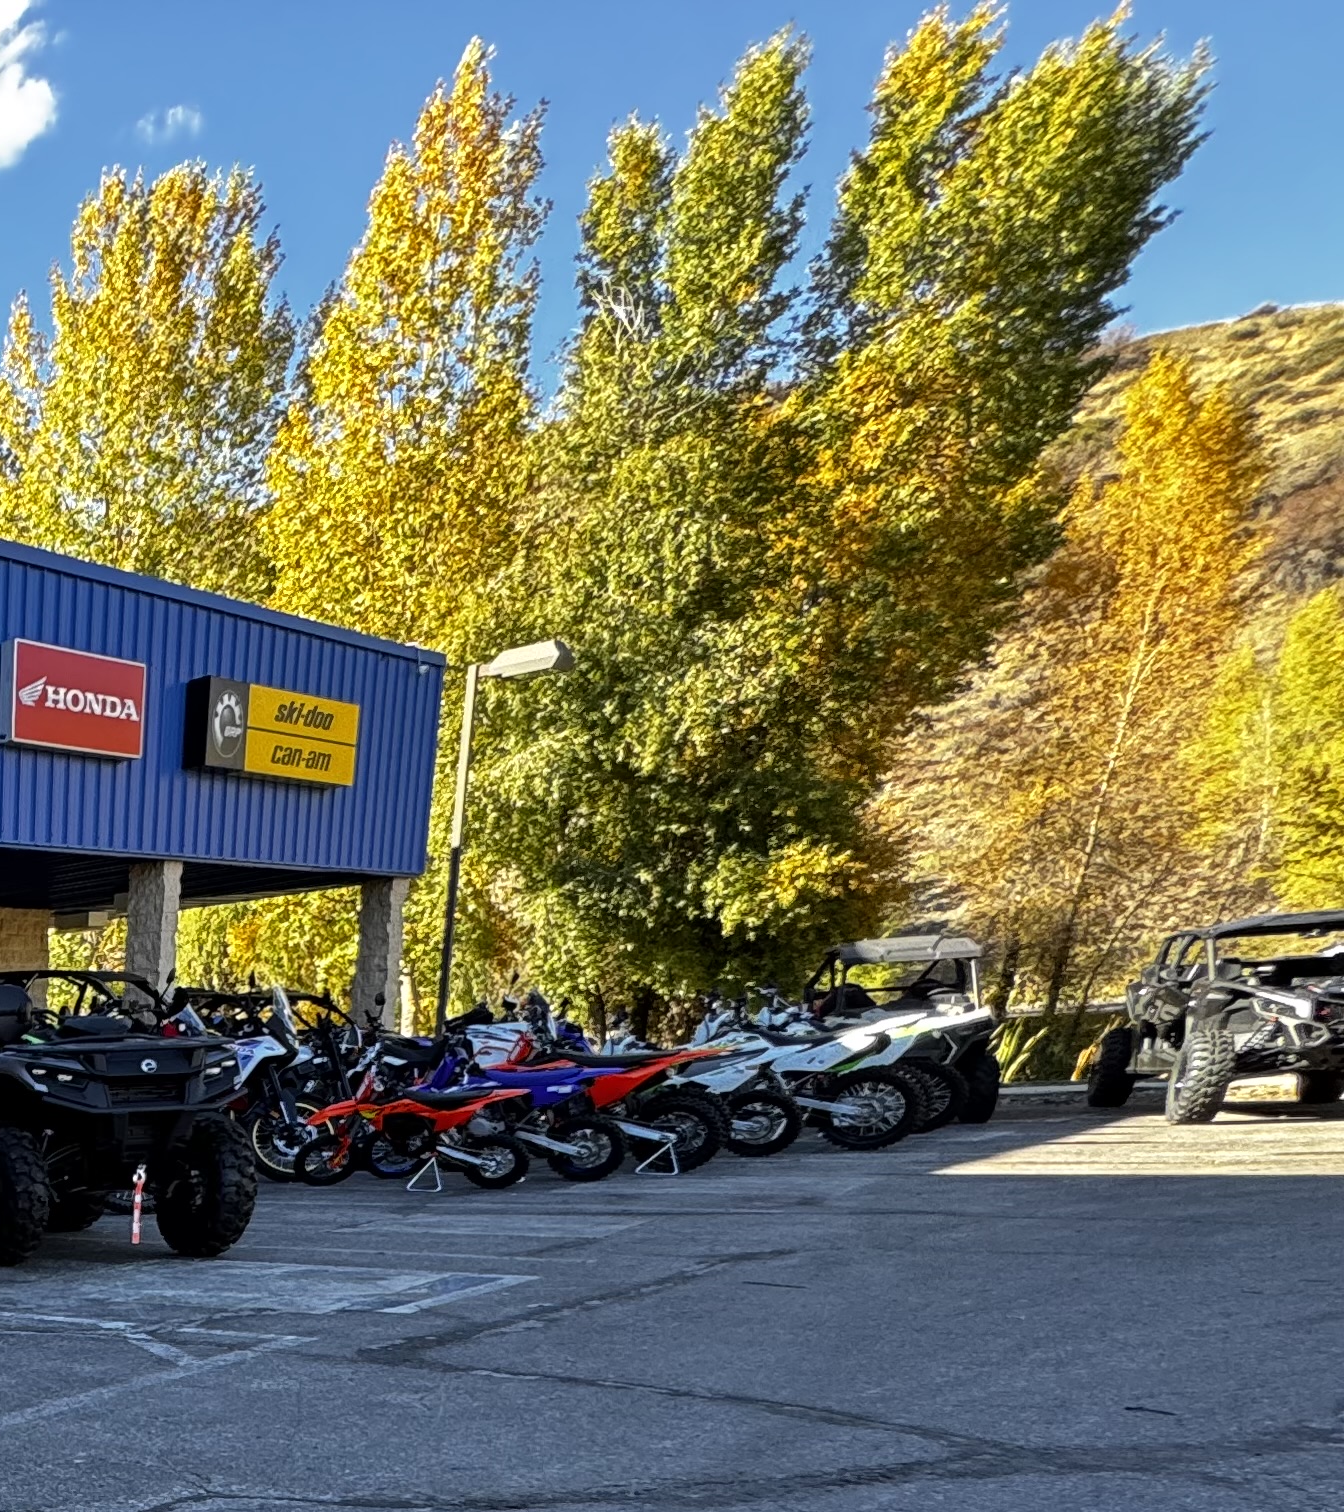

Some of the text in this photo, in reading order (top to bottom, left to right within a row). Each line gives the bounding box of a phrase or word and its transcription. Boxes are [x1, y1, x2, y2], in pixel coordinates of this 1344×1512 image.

[44, 685, 140, 722] HONDA
[274, 701, 335, 731] ski-doo
[271, 745, 332, 772] can-am
